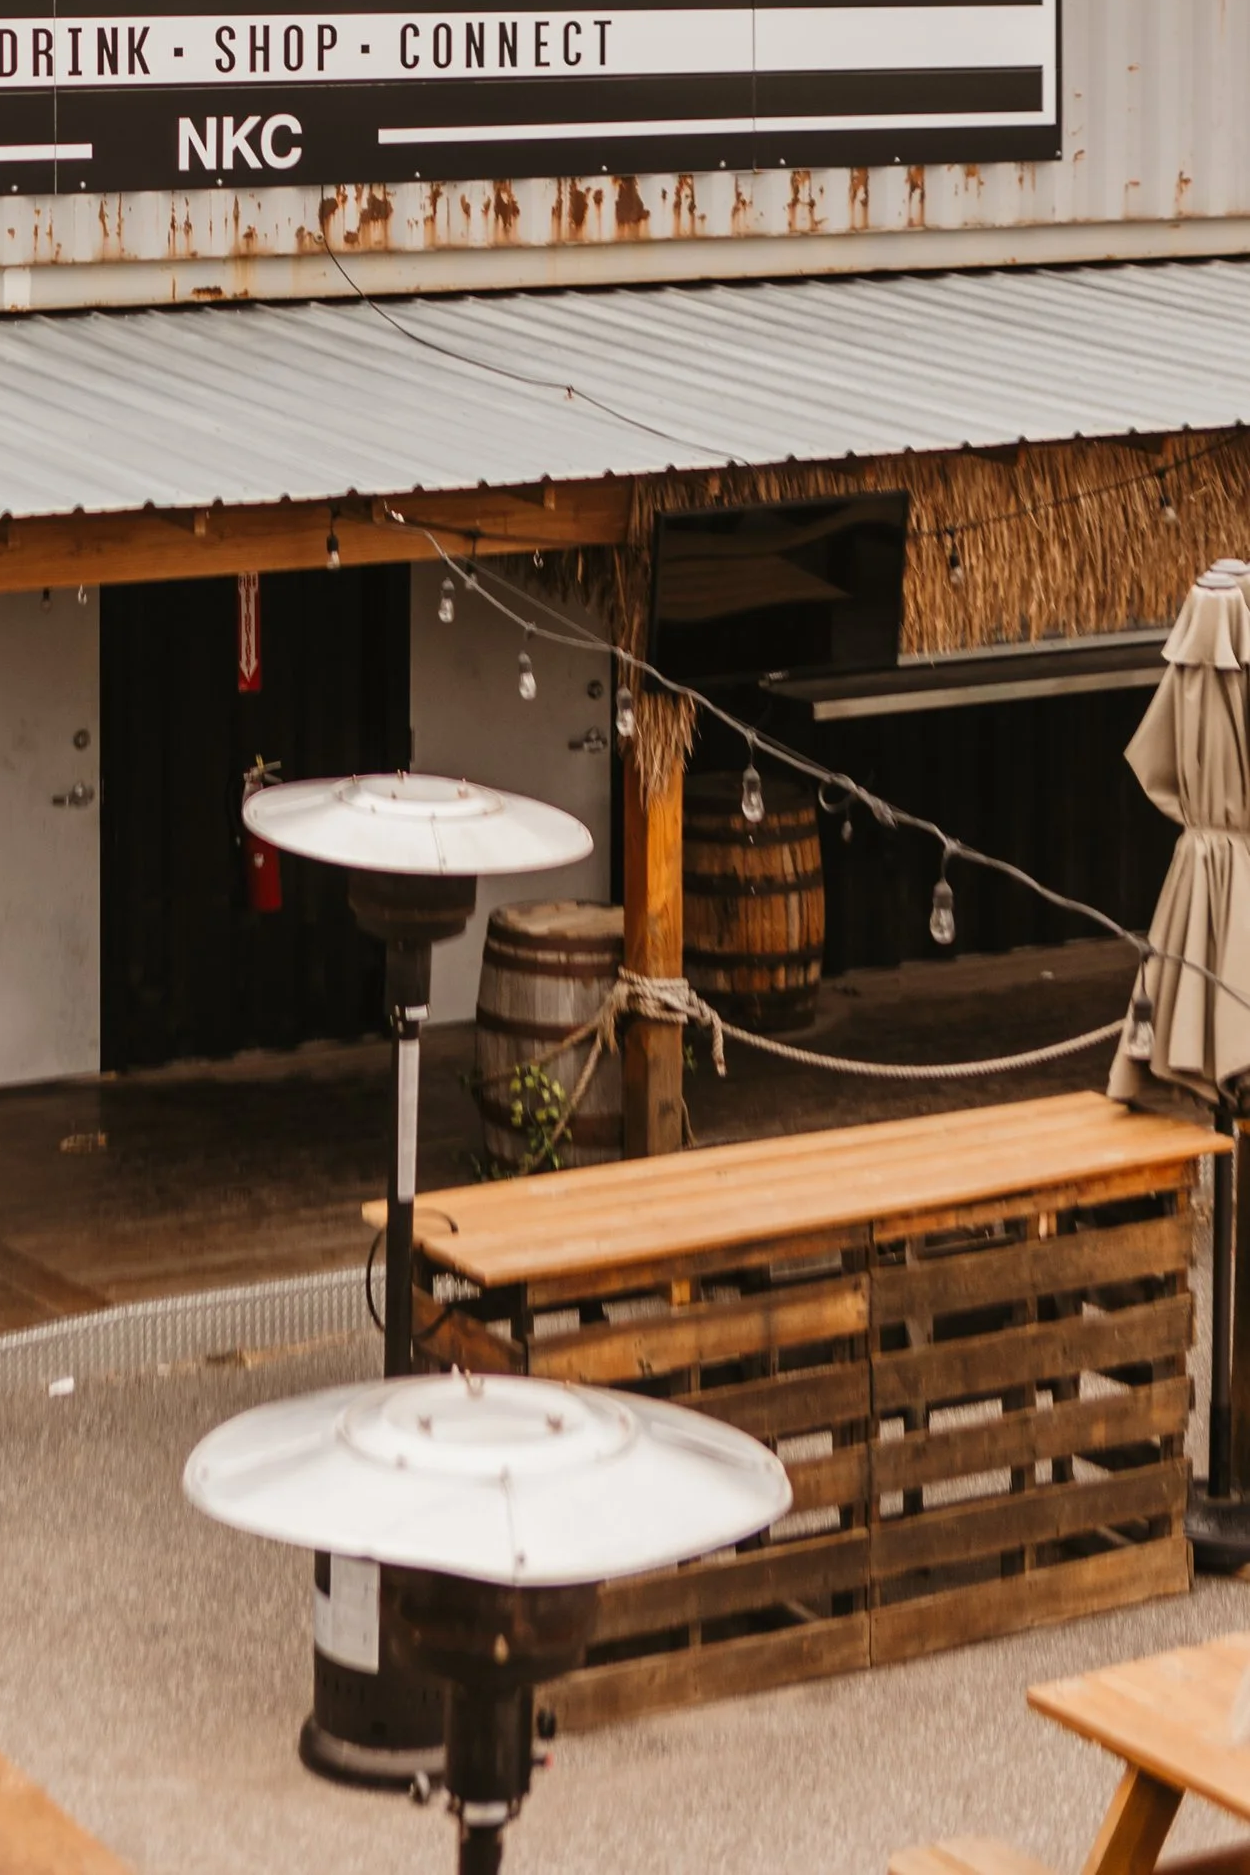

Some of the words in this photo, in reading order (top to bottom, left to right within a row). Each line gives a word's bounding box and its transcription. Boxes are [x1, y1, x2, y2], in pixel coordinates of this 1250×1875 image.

[214, 23, 338, 75] SHOP
[399, 19, 613, 70] CONNECT
[177, 113, 303, 172] NKC
